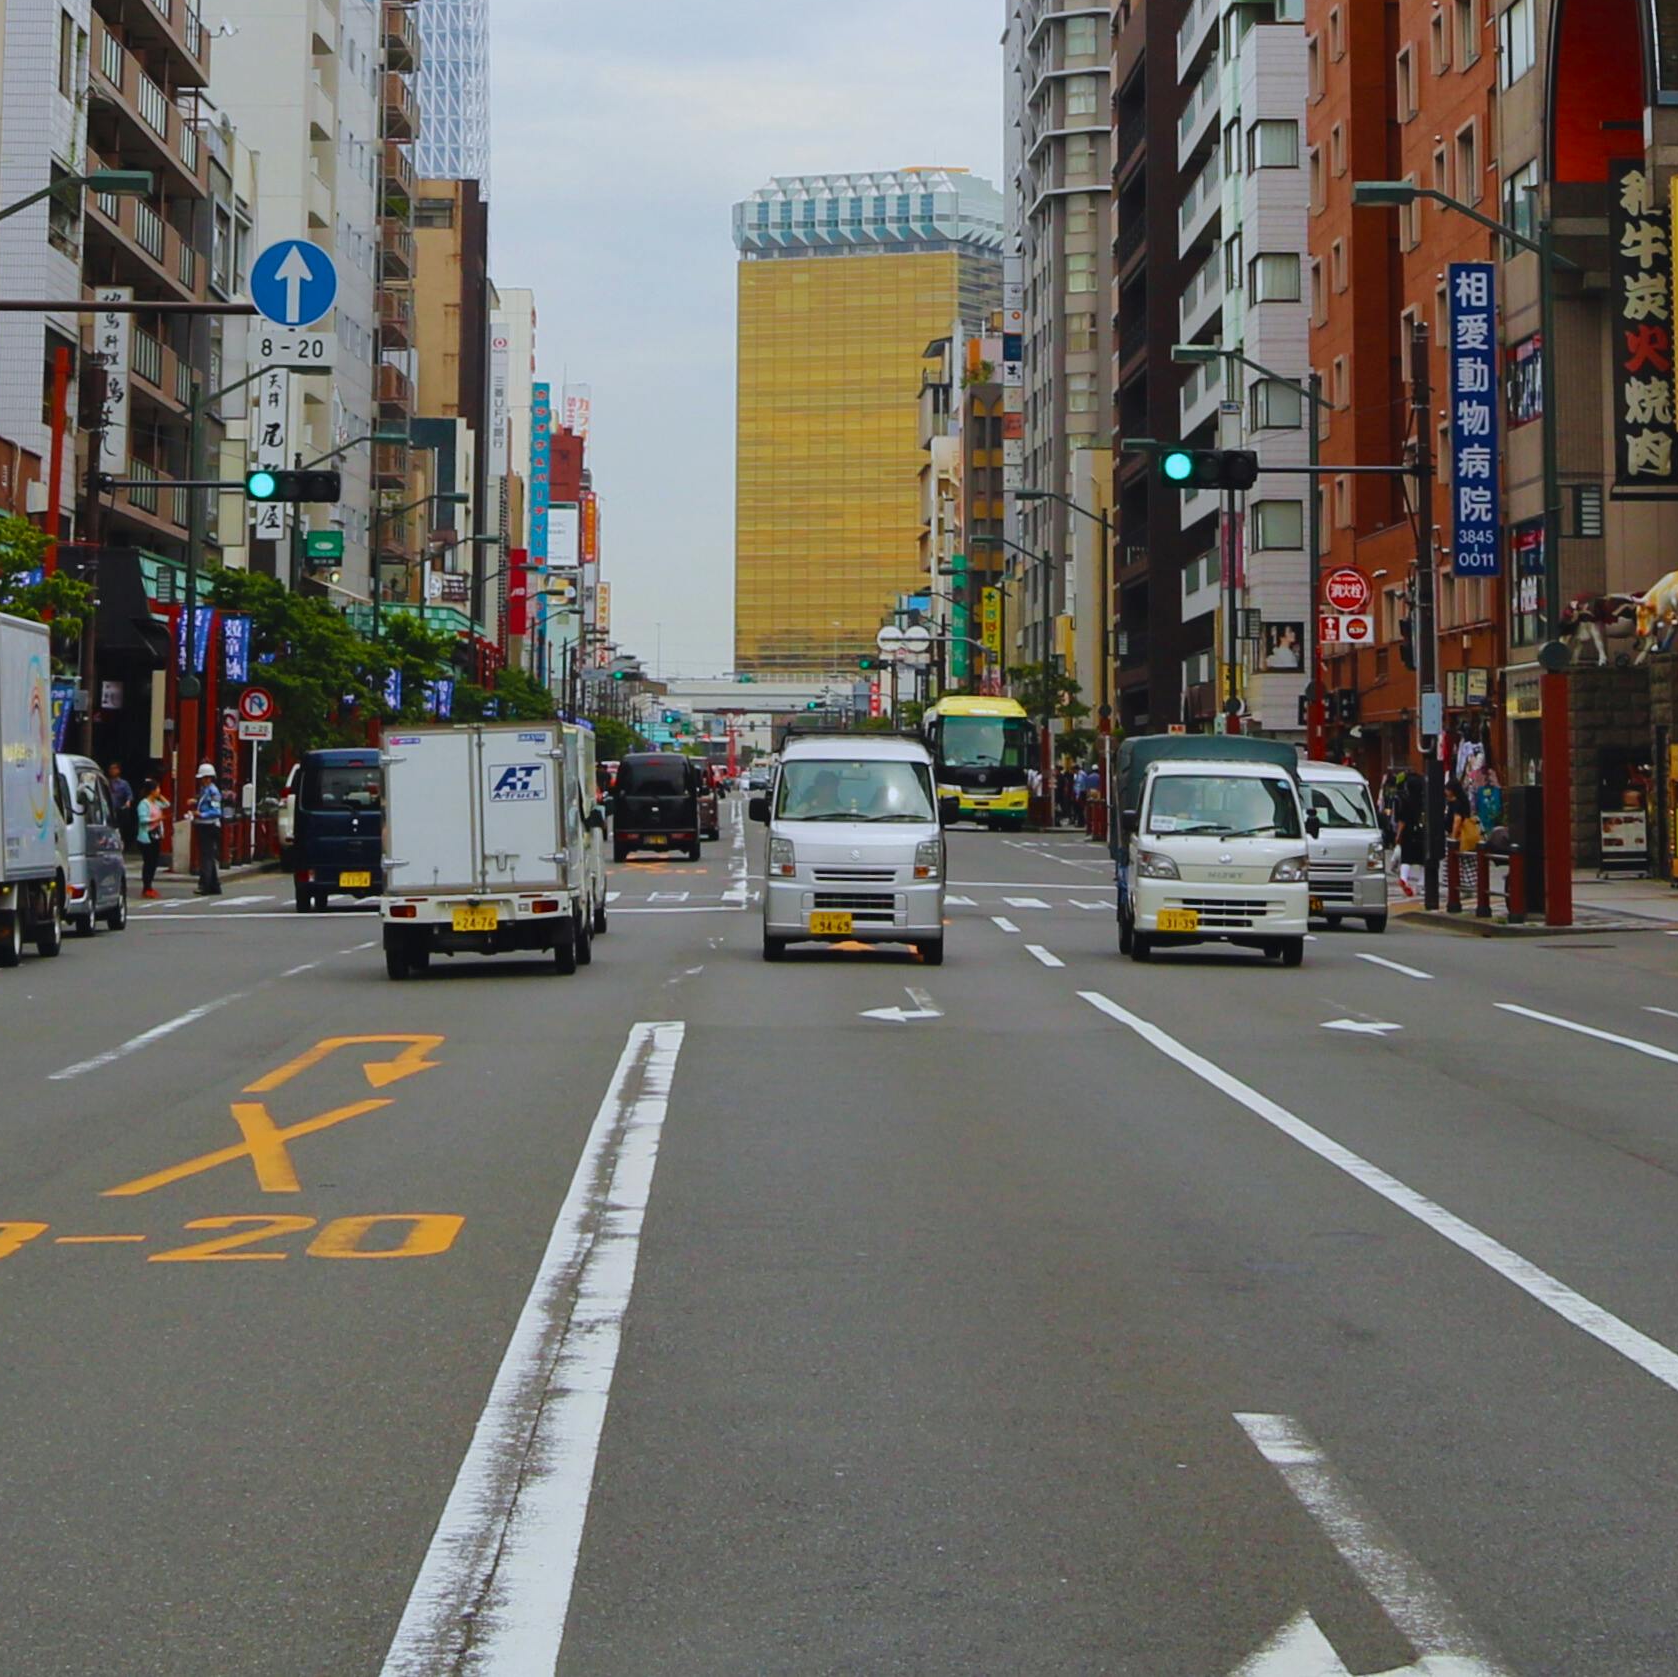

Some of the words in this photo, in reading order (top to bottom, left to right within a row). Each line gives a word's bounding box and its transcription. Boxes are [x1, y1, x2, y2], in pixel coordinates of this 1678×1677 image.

[1455, 271, 1492, 523] 相愛動物病院
[260, 422, 284, 530] 尾屋
[1458, 529, 1494, 544] 3845
[1458, 552, 1495, 568] 0011
[1330, 582, 1363, 599] 消火栓
[493, 766, 542, 791] AT
[461, 917, 496, 930] 24-76
